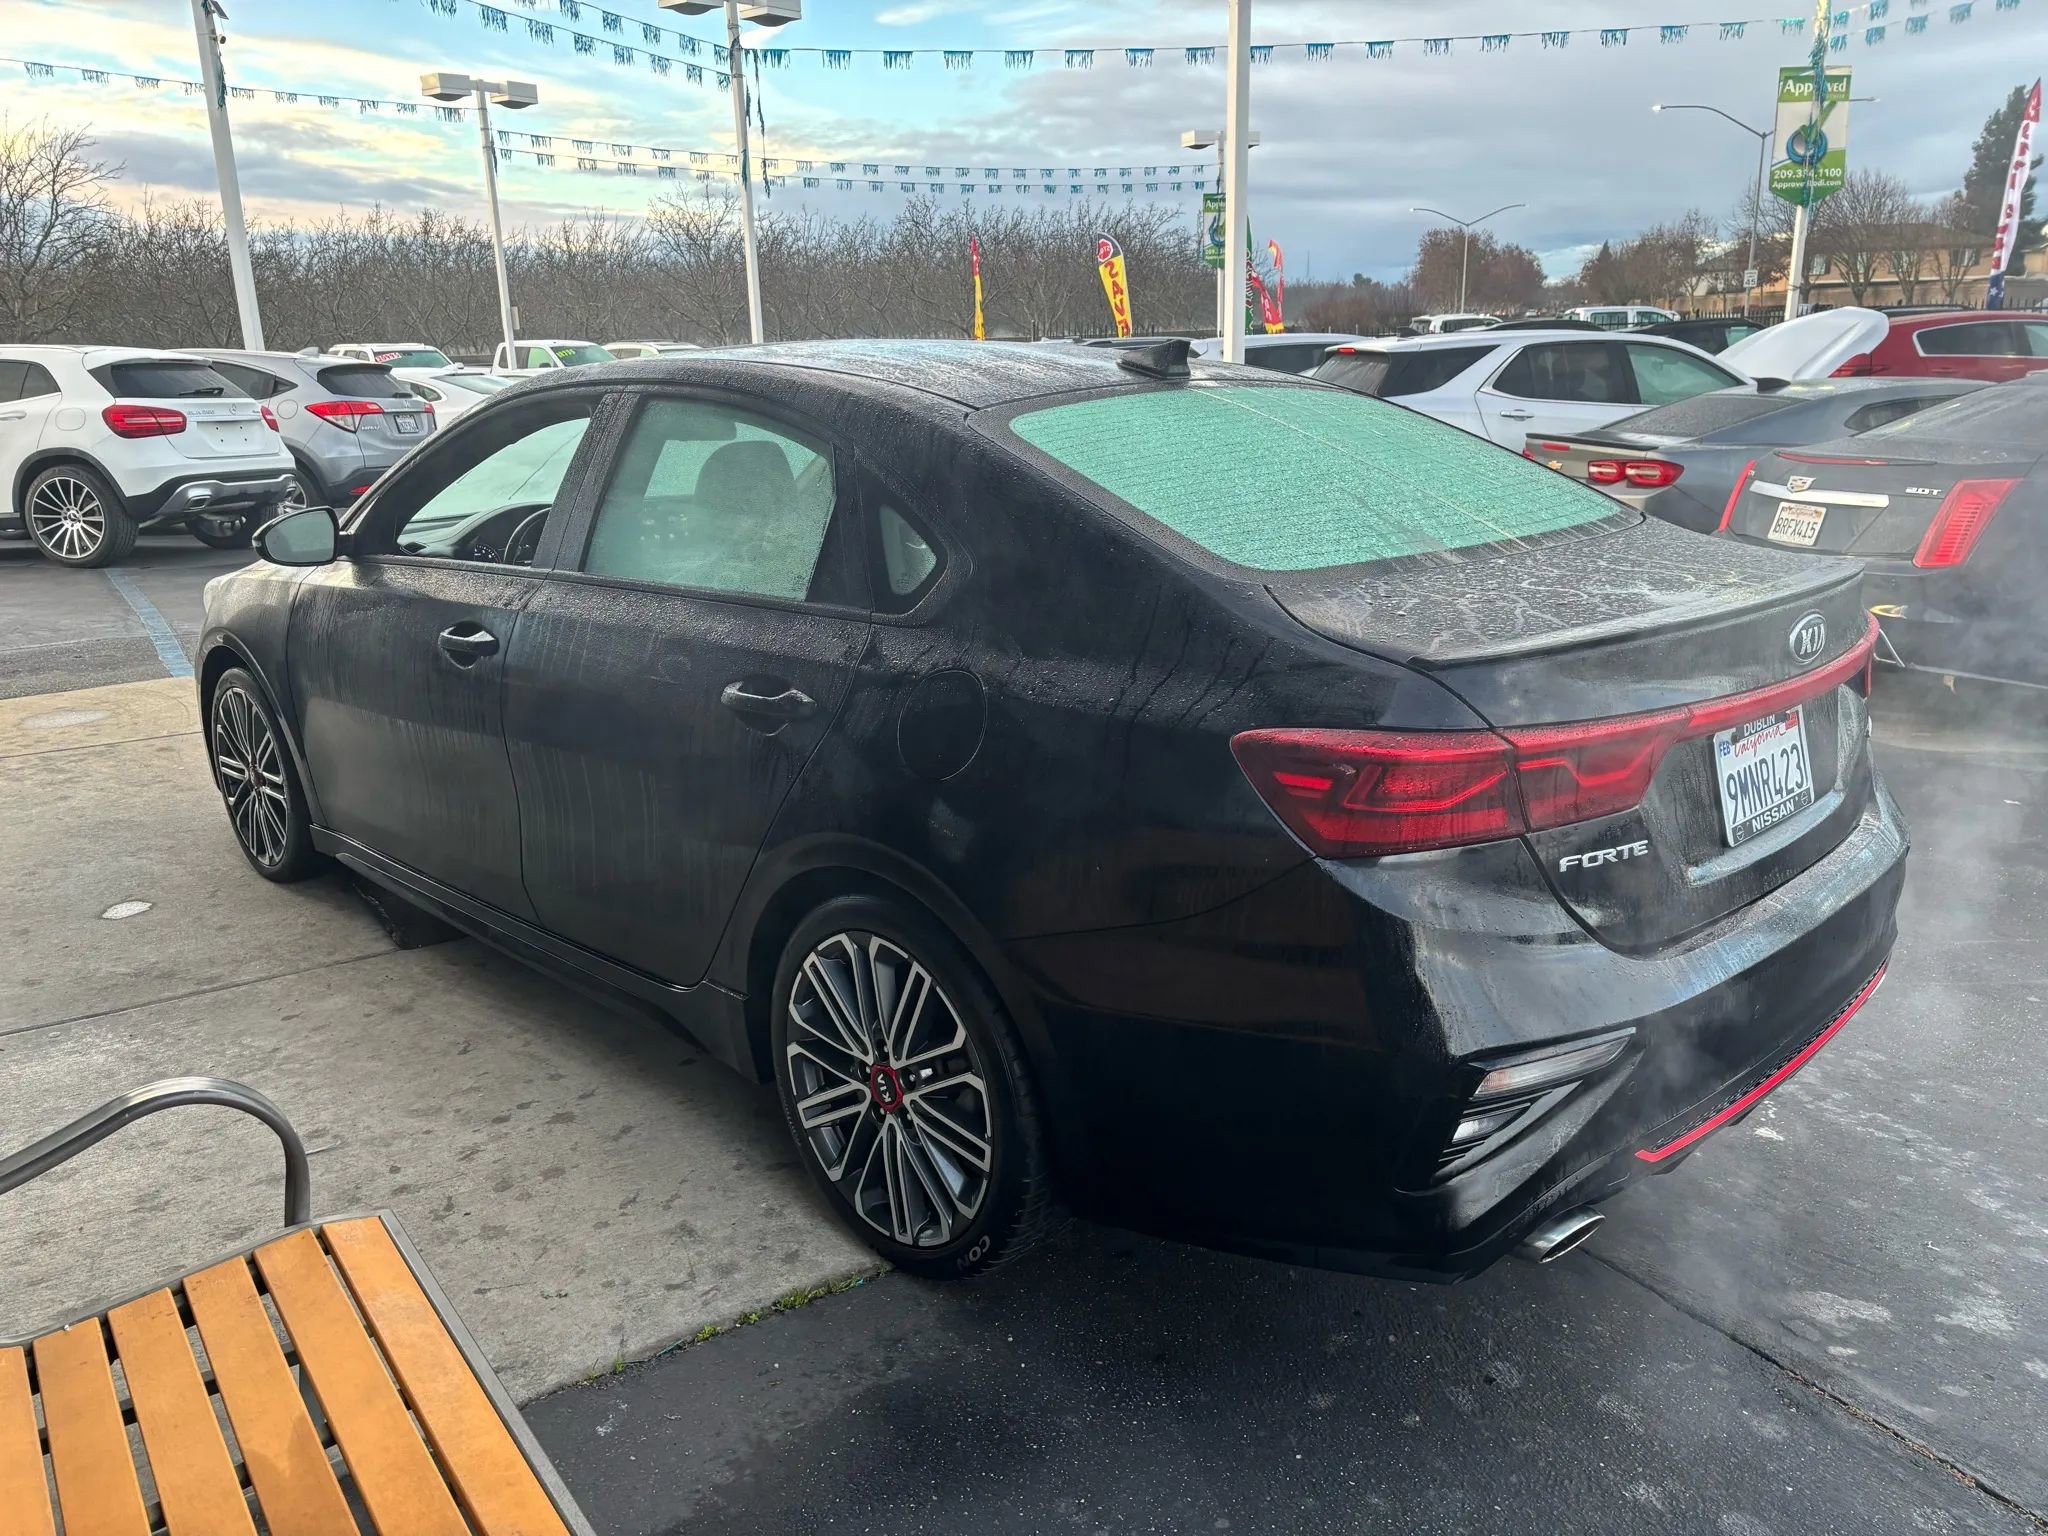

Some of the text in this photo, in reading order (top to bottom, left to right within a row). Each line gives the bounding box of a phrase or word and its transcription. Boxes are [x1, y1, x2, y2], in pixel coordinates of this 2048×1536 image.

[1800, 623, 1825, 655] KIA
[1734, 725, 1787, 757] California
[1744, 714, 1776, 736] DUBLIN
[1718, 741, 1731, 757] FEB
[1726, 742, 1804, 825] 9MNR423
[1752, 799, 1795, 832] NISSAN
[1559, 839, 1649, 873] FORTE
